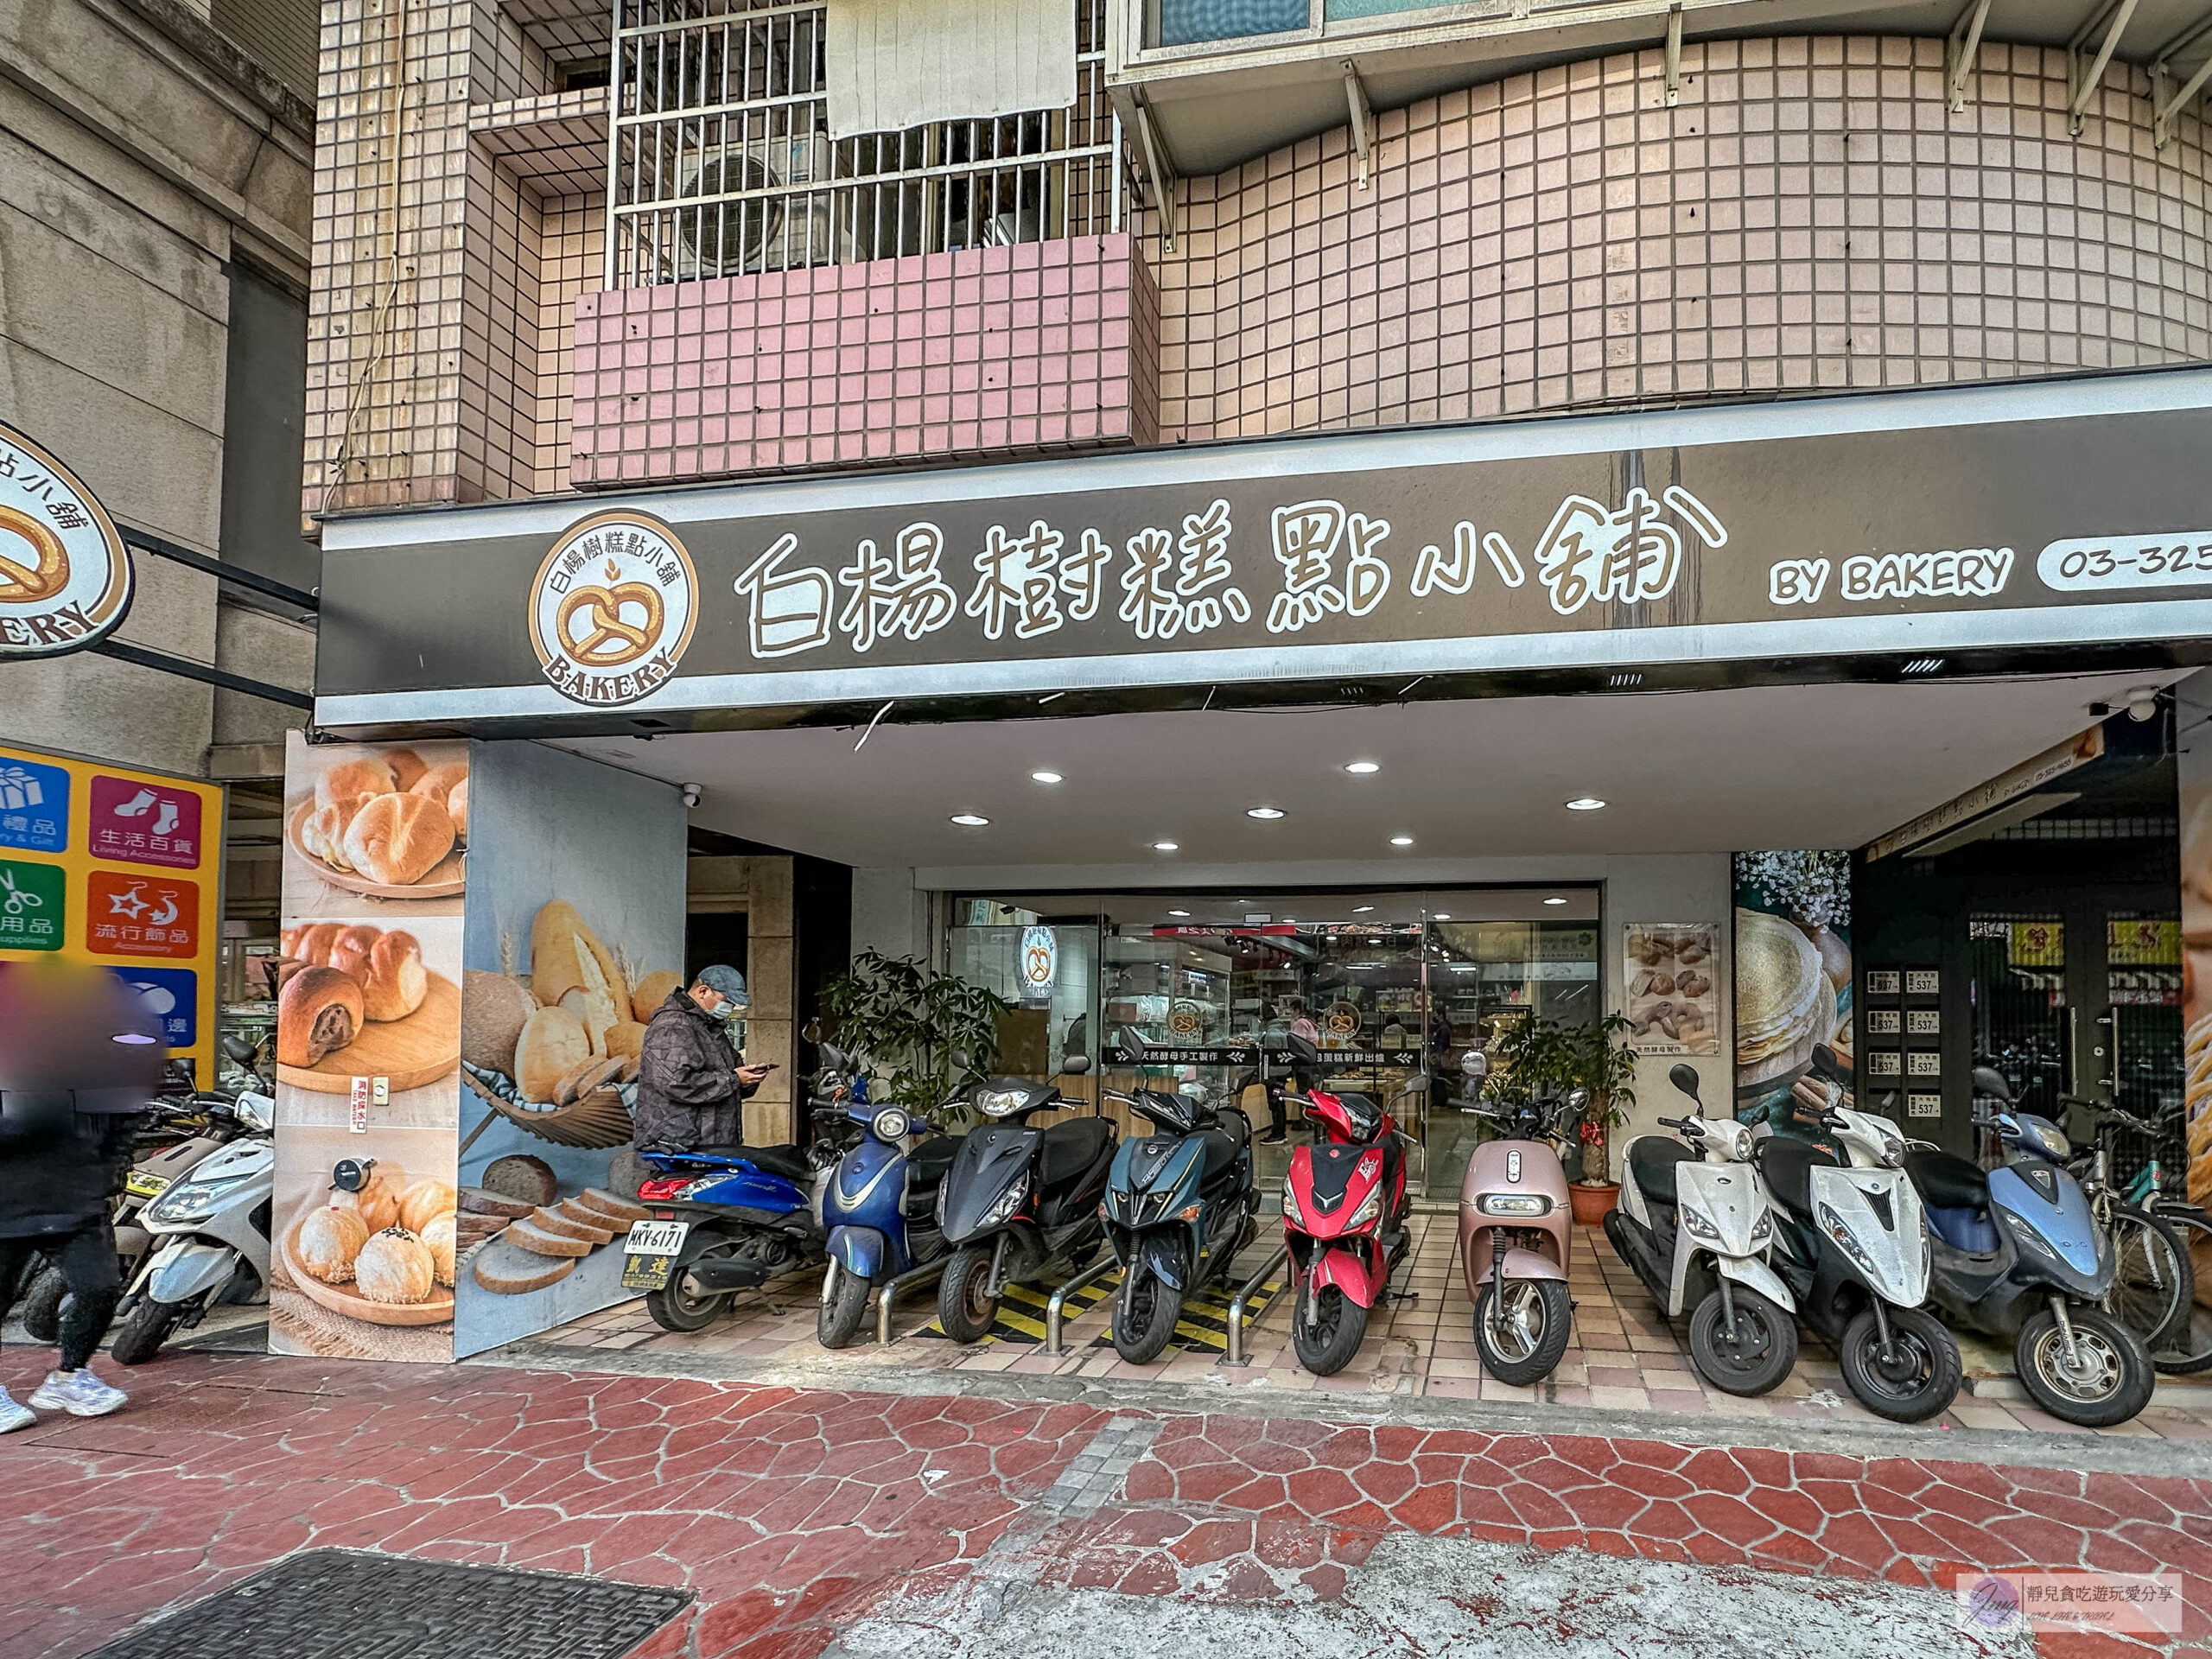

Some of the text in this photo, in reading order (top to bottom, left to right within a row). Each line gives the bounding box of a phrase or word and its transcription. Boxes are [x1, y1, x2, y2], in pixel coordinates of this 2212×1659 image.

[550, 531, 681, 594] 白楊樹糕點小舖
[735, 487, 1726, 658] 白楊樹糕點小舖
[1770, 548, 2014, 604] BY BAKERY
[542, 646, 677, 702] BAKERY
[3, 814, 56, 836] 禮品
[99, 829, 193, 855] 生活百貨
[92, 844, 128, 858] Living
[0, 916, 53, 933] 用品
[95, 923, 189, 944] 流行飾品
[1916, 980, 1932, 990] 537
[1878, 1019, 1893, 1031] 537
[1917, 1020, 1933, 1031] 537
[1141, 1051, 1218, 1062] 天然酵母手工製作
[1878, 1061, 1893, 1072] 537
[1917, 1062, 1933, 1072] 537
[1918, 1103, 1934, 1115] 537
